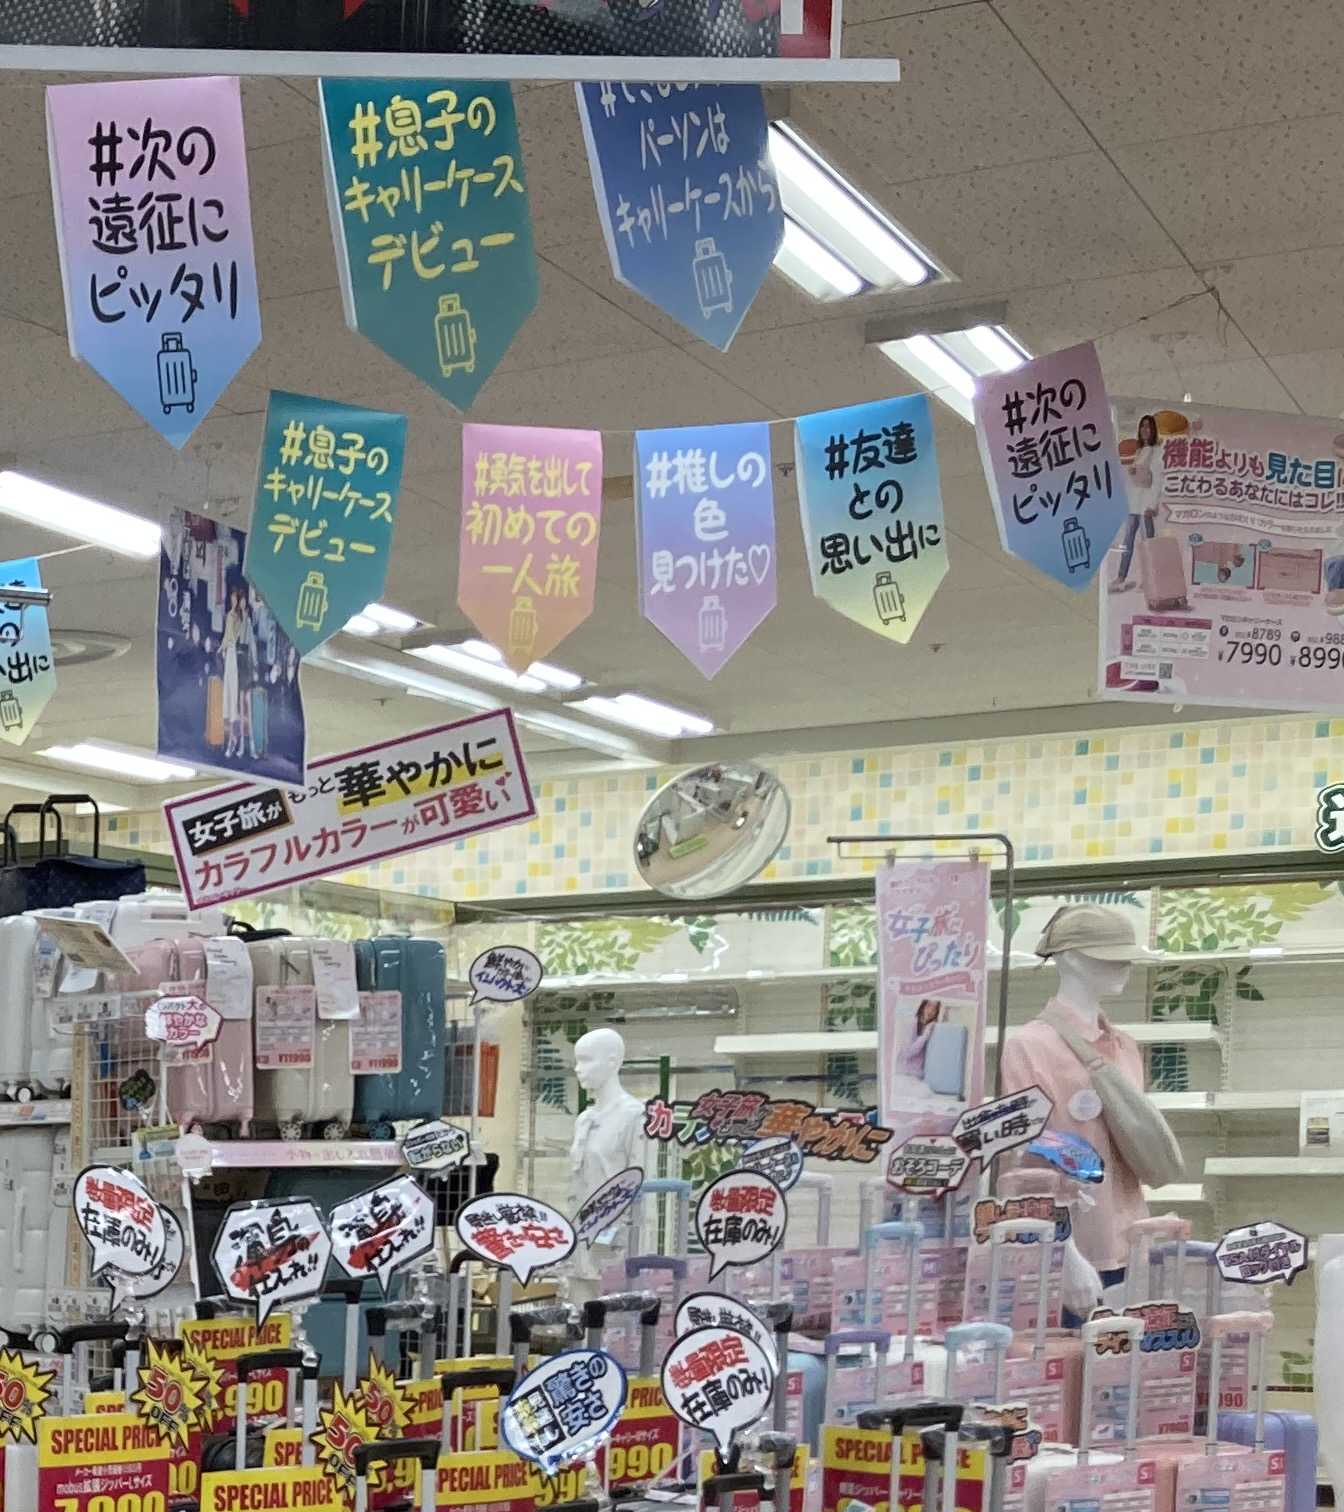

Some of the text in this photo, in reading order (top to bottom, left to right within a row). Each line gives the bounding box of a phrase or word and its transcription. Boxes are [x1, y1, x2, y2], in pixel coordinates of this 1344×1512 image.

[89, 117, 217, 186] #次の
[348, 93, 496, 165] #息子の
[344, 155, 524, 221] キャリーケース
[89, 195, 230, 255] 遠征に
[366, 228, 515, 288] デビュー
[90, 270, 239, 323] ピッタリ
[1001, 378, 1088, 432] #次の
[279, 420, 389, 477] #息子の
[644, 445, 767, 500] #推しの
[824, 423, 918, 480] #友達
[1004, 420, 1101, 479] 遠征に
[264, 471, 393, 523] キャリーケース
[475, 451, 593, 500] #勇気を出して
[848, 480, 904, 521] との
[1011, 459, 1113, 526] ピッタリ
[270, 513, 376, 561] デビュー
[467, 504, 597, 545] 初めての
[693, 499, 726, 541] 色
[819, 523, 942, 576] 思い出に
[482, 559, 582, 598] 一人旅
[1218, 642, 1282, 666] ¥7990
[51, 1425, 118, 1455] SPECIAL
[214, 1476, 333, 1512] SPECIAL PRICE
[495, 1461, 528, 1489] PRICE
